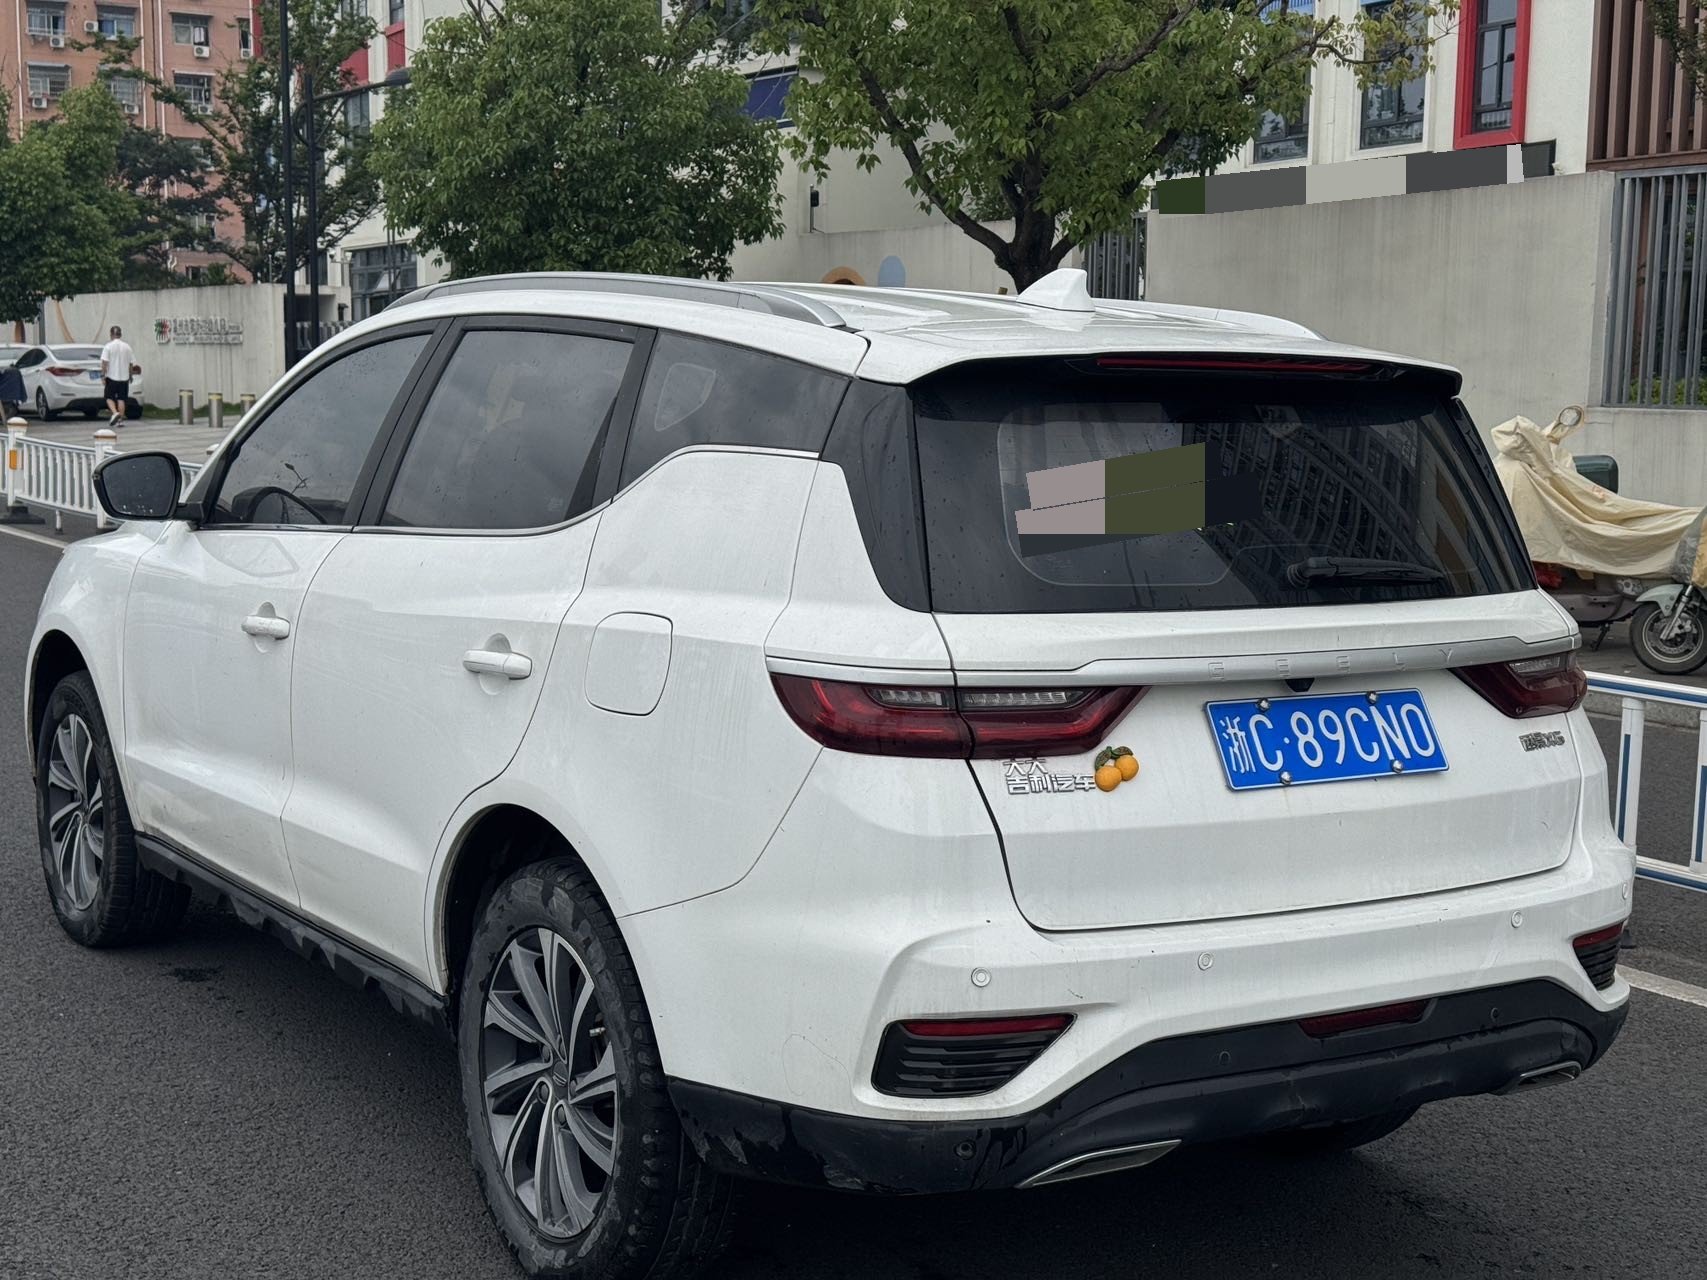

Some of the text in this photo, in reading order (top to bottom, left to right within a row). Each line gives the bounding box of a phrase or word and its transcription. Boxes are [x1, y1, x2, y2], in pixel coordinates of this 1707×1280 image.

[1207, 647, 1452, 681] GEELY
[1006, 774, 1096, 795] 吉利汽车
